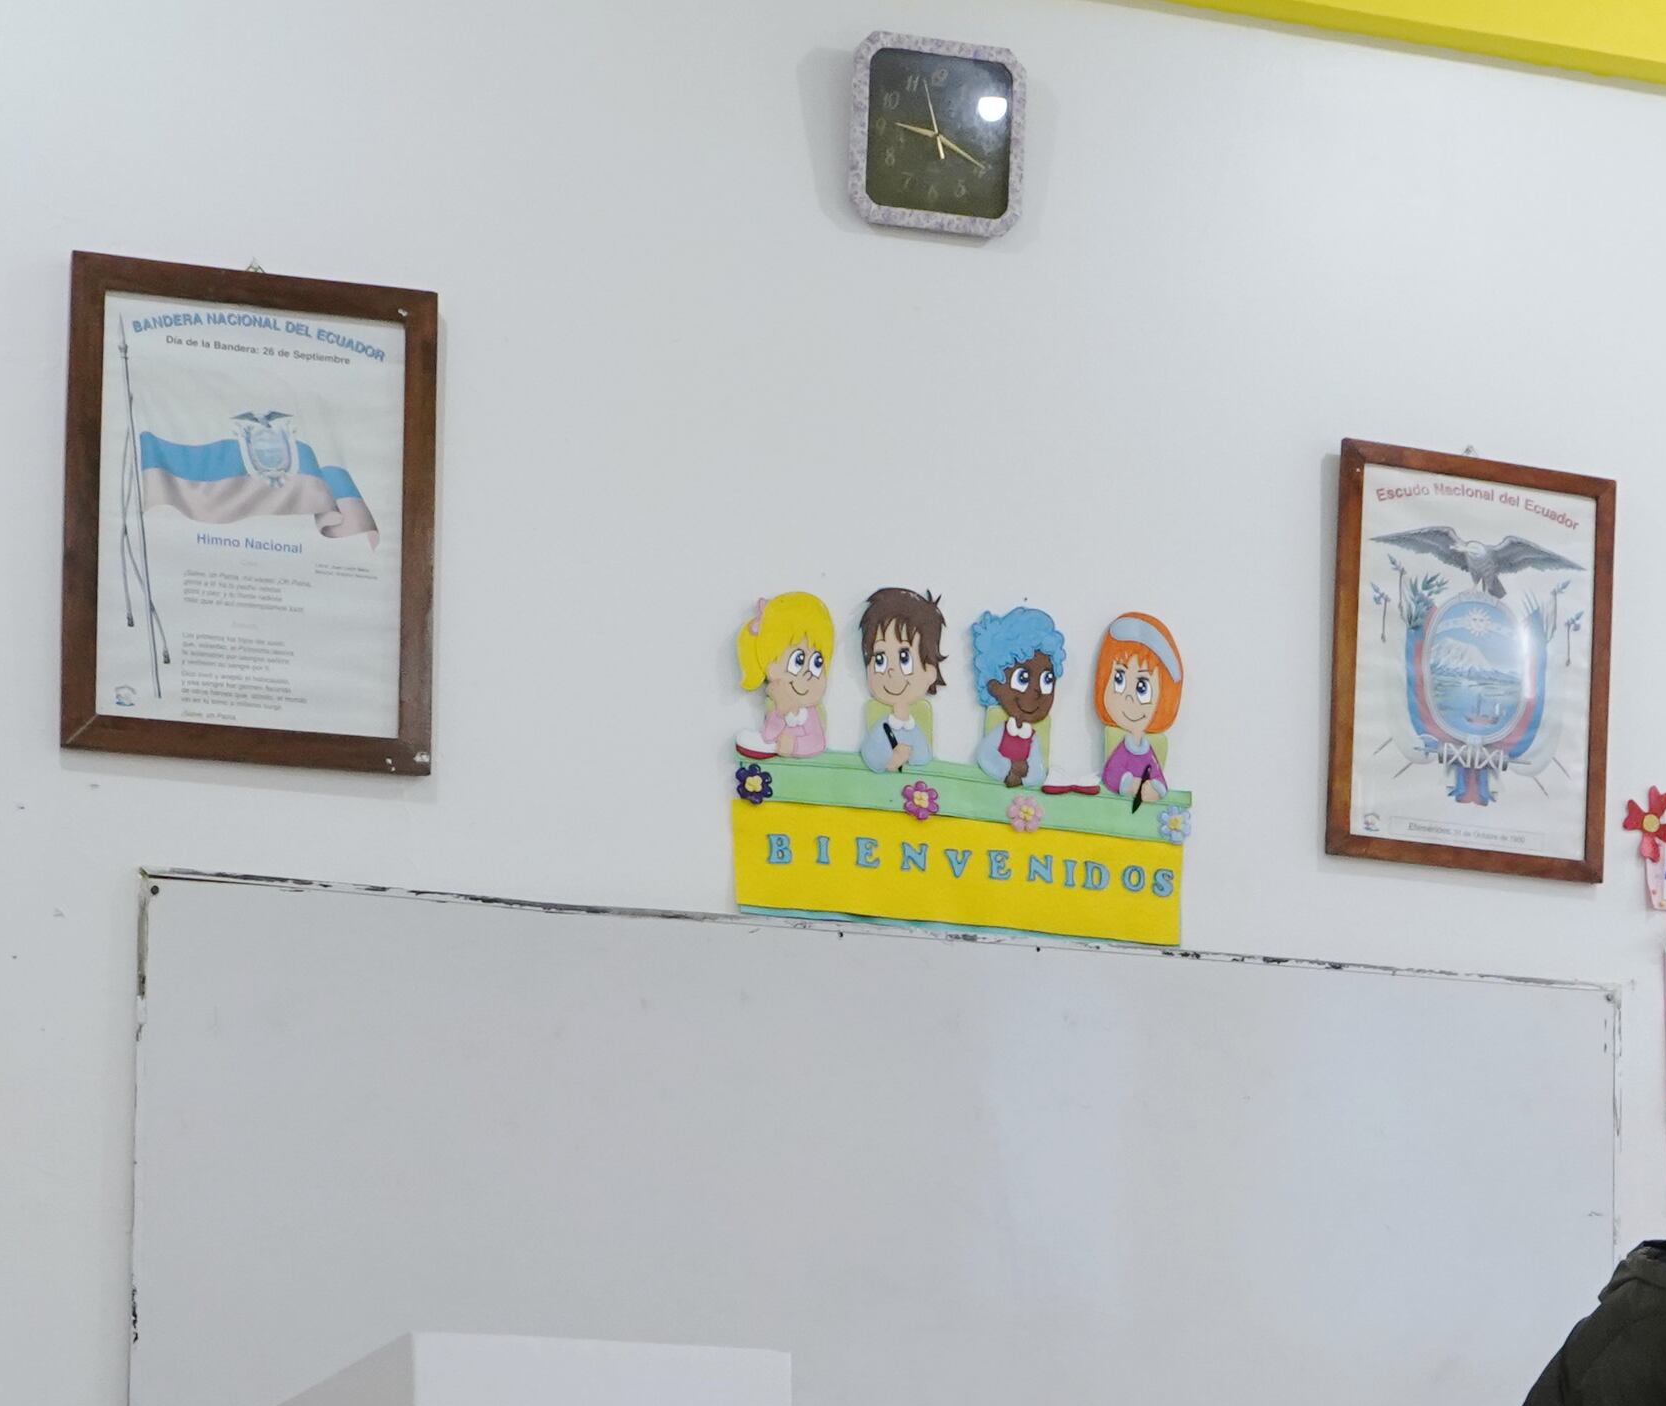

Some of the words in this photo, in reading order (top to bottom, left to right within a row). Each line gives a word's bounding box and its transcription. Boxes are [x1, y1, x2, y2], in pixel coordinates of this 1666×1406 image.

[133, 312, 203, 333] BANDERA
[207, 313, 281, 331] NACIONAL
[285, 321, 311, 337] DEL
[317, 329, 386, 361] ECUADOR
[186, 338, 199, 347] de
[201, 339, 211, 349] la
[214, 341, 259, 354] Bandera:
[277, 347, 290, 358] de
[293, 350, 351, 366] Septiembre
[1376, 484, 1430, 502] Escudo
[1434, 482, 1494, 501] Nacional
[1499, 493, 1520, 507] del
[1524, 499, 1580, 531] Ecuador
[196, 533, 241, 548] Himno
[245, 538, 303, 554] Nacional
[767, 833, 1174, 898] BIENVENIDOS
